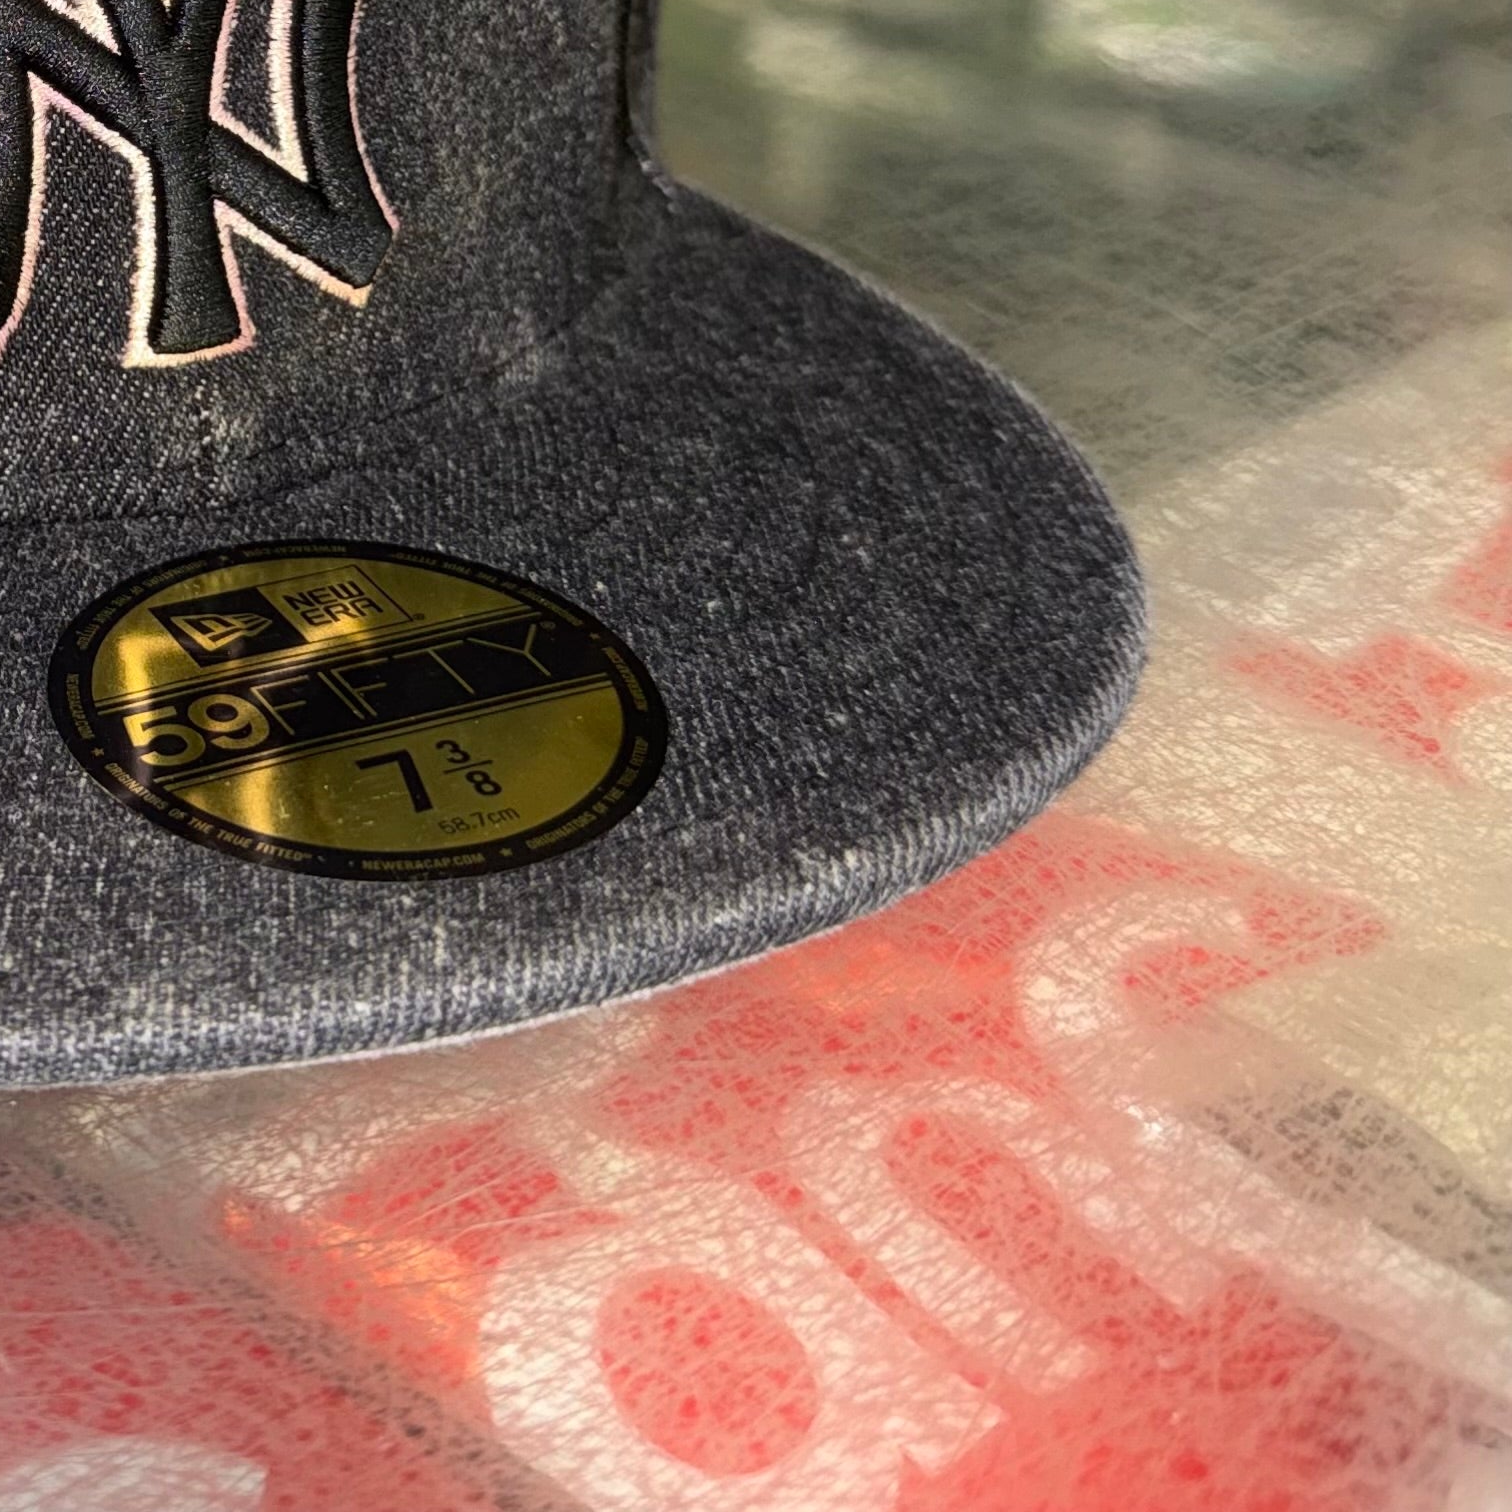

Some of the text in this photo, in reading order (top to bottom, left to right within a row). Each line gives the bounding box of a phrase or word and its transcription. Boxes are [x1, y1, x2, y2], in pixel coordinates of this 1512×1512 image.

[282, 580, 364, 614] NEW
[301, 596, 383, 628] ERA
[357, 749, 434, 813] 7
[104, 763, 169, 811] ORIGINATORS
[188, 816, 215, 835] THE
[216, 829, 253, 848] TRUE
[439, 805, 520, 834] 58.7cm
[362, 852, 486, 871] NEWERACAP.COM
